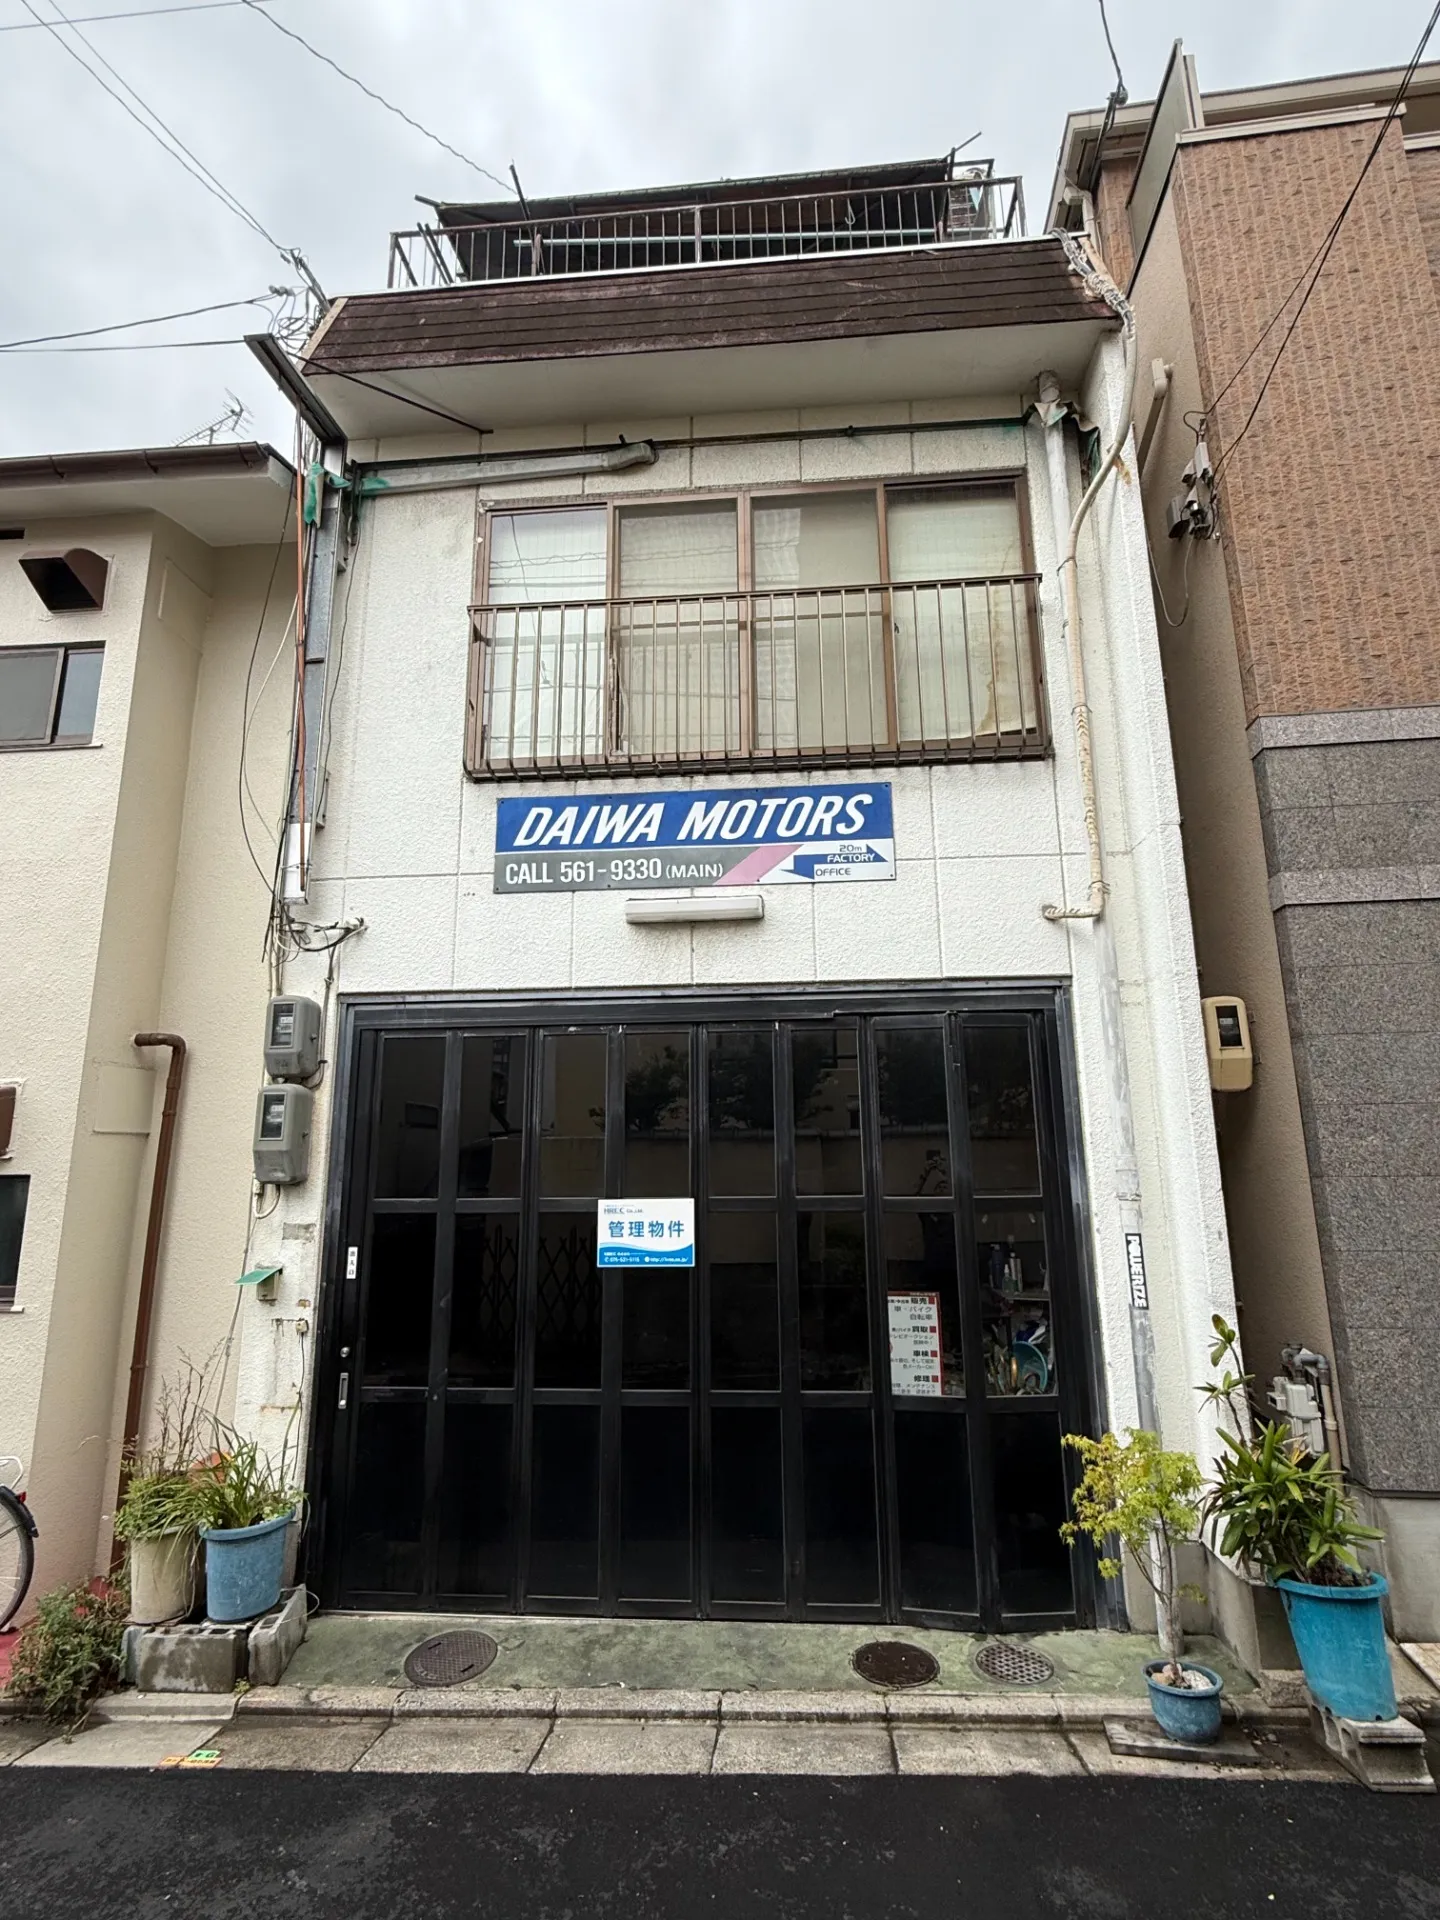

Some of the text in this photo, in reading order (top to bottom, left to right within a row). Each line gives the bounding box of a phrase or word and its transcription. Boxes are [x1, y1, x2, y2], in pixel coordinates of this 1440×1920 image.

[513, 793, 873, 846] DAIWA MOTORS
[839, 844, 863, 853] 20m
[826, 852, 875, 863] FACTORY
[505, 858, 723, 884] CALL 561-9330 (MAIN)
[815, 867, 852, 876] OFFICE
[608, 1220, 685, 1238] 管理物件
[910, 1297, 927, 1305] 販売
[909, 1313, 933, 1321] 自転車
[911, 1325, 928, 1333] 買取
[913, 1375, 930, 1383] 修理
